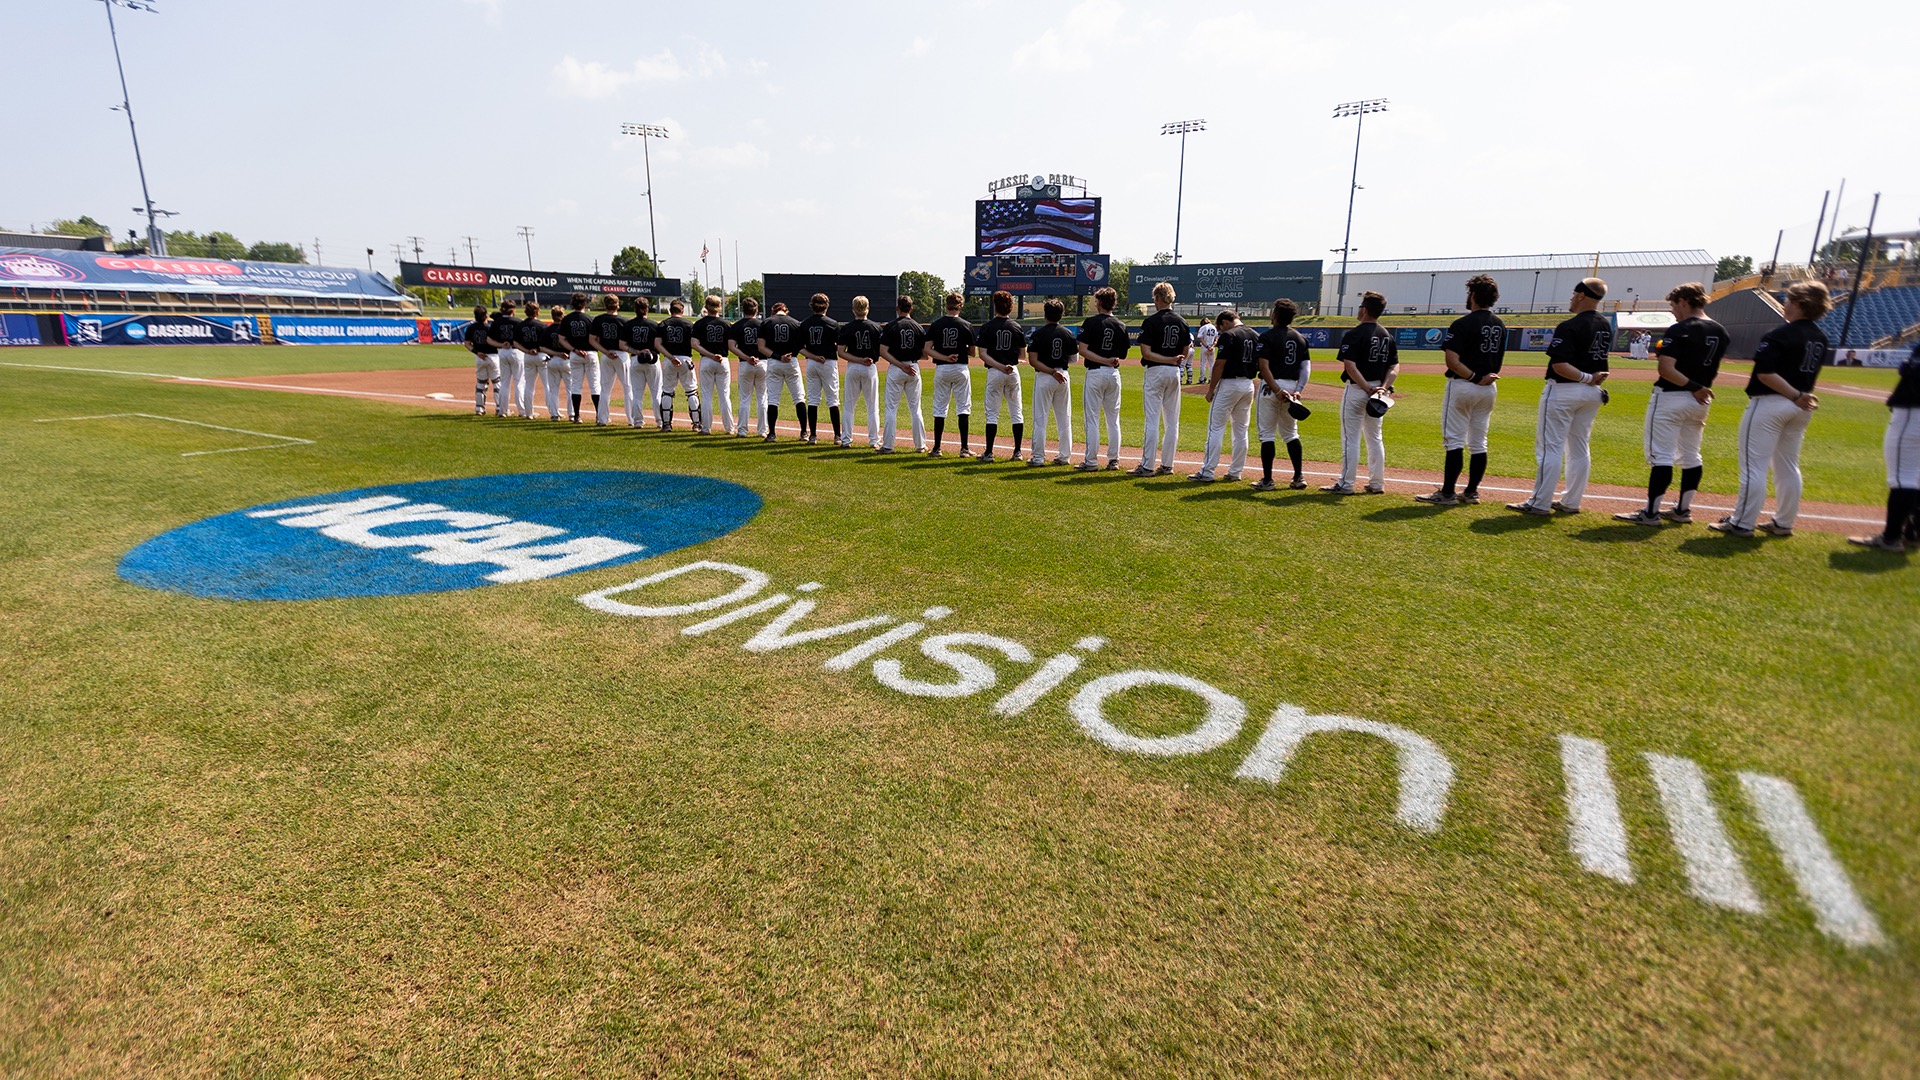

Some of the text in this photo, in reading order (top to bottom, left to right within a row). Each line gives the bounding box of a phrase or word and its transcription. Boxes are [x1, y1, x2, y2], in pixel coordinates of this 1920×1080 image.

[988, 174, 1075, 193] CLASSIC PARK
[108, 260, 233, 273] CLASSIC
[245, 266, 294, 277] AUTO
[297, 270, 357, 281] GROUP
[427, 270, 558, 287] CLASSIC AUTO GROUP
[1197, 267, 1245, 276] FOR EVERY
[1196, 276, 1245, 292] CARE
[148, 324, 214, 338] BASEBALL
[297, 325, 345, 336] BASEBALL
[347, 325, 414, 337] CHAMPIONSHIP
[632, 325, 650, 343] 27
[666, 325, 684, 343] 23
[706, 324, 725, 343] 22
[774, 323, 790, 343] 19
[808, 326, 824, 345] 17
[855, 329, 872, 350] 14
[900, 328, 915, 349] 13
[942, 327, 959, 349] 12
[995, 329, 1012, 351] 10
[1101, 327, 1115, 351] 2
[1162, 324, 1180, 349] 16
[1206, 328, 1215, 337] 43
[1480, 325, 1503, 353] 33
[1051, 337, 1063, 360] 8
[1284, 339, 1298, 365] 3
[1368, 336, 1390, 363] 24
[1702, 335, 1720, 367] 7
[245, 495, 645, 585] NCAA
[578, 560, 1884, 949] Division III
